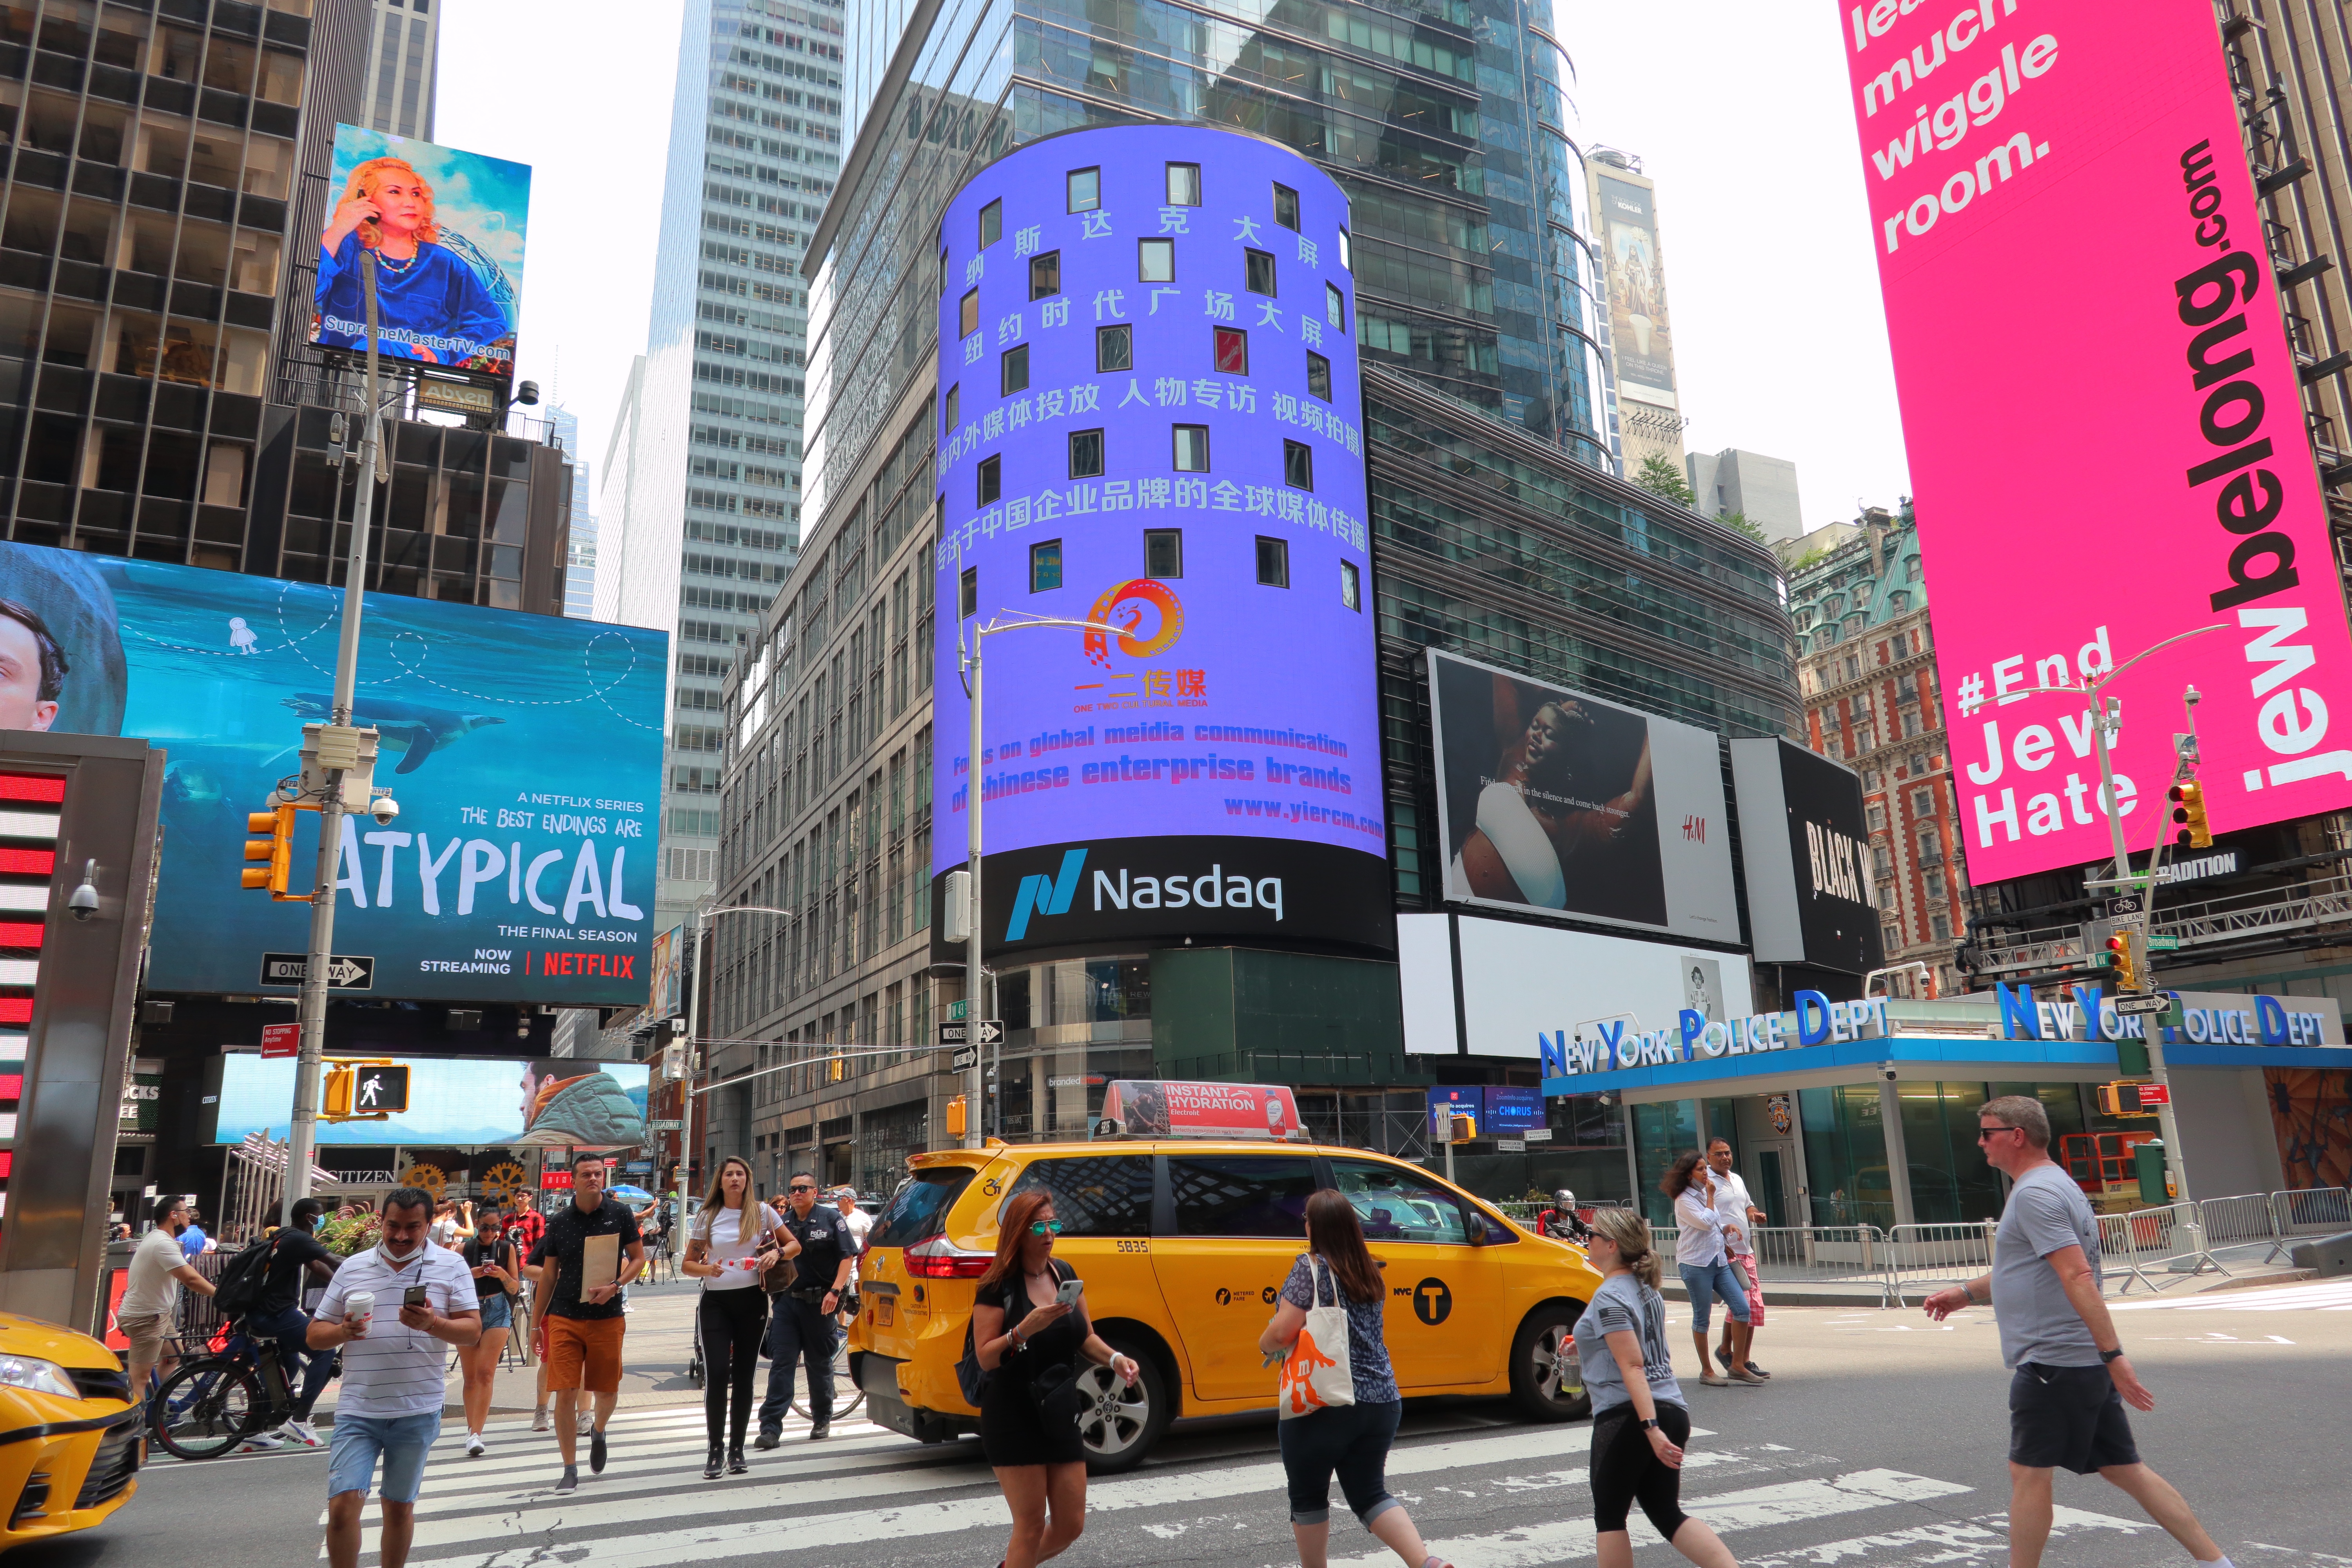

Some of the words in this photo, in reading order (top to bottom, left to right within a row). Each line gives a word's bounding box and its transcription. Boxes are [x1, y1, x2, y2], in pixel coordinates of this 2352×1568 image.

[1864, 0, 2017, 117] much
[1872, 33, 2058, 181] wiggle
[1884, 132, 2050, 254] room.
[1957, 625, 2116, 718] #End
[1074, 704, 1093, 713] ONE
[1097, 702, 1119, 710] TWO
[1178, 699, 1208, 707] MEDIA
[954, 748, 993, 777] Fos
[1000, 741, 1022, 760] on
[1029, 726, 1094, 758] global
[1105, 721, 1184, 744] meidia
[1194, 723, 1348, 758] communication
[1966, 699, 2122, 786] Jew
[953, 783, 967, 813] of
[1082, 753, 1254, 785] enterprise
[1266, 757, 1352, 795] brands
[517, 792, 528, 802] A
[532, 793, 592, 808] NETFLIX
[595, 799, 644, 813] SERIES
[1480, 775, 1495, 787] Find
[1497, 782, 1523, 794] strength
[1524, 786, 1530, 795] in
[1532, 788, 1541, 797] the
[1543, 791, 1563, 802] silence
[1564, 797, 1575, 806] and
[1576, 800, 1591, 809] come
[1592, 801, 1605, 812] back
[1606, 807, 1630, 818] stronger.
[1224, 799, 1383, 839] www.yiercm.com
[1973, 774, 2138, 848] Hate
[461, 806, 488, 826] THE
[497, 808, 535, 829] BEST
[543, 813, 606, 836] ENDINGS
[615, 818, 643, 838] ARE
[1682, 814, 1705, 845] H&M
[337, 814, 644, 924] ATYPICAL
[1806, 820, 1860, 904] BLACK
[1094, 864, 1283, 922] Nasdaq
[2111, 916, 2125, 924] BIKE
[2127, 913, 2144, 922] LANE
[497, 925, 528, 938] THE
[532, 927, 574, 940] FINAL
[578, 929, 637, 943] SEASON
[2148, 937, 2176, 949] Broadway
[474, 949, 512, 961] NOW
[2097, 955, 2105, 965] W
[279, 964, 307, 976] ONE
[420, 960, 511, 975] STREAMING
[544, 952, 636, 980] NETFLIX
[952, 1005, 956, 1018] W
[958, 1003, 964, 1016] 43
[2144, 999, 2161, 1008] WAY
[948, 1029, 966, 1038] ONE
[980, 1029, 993, 1037] AY
[965, 1053, 974, 1063] WAY
[1165, 1085, 1229, 1098] INSTANT
[1168, 1096, 1256, 1111] HYDRATION
[1101, 1120, 1110, 1134] 5B35
[328, 1170, 396, 1183] CITIZEN
[1117, 1240, 1149, 1253] 5B35
[1393, 1287, 1412, 1296] NYC
